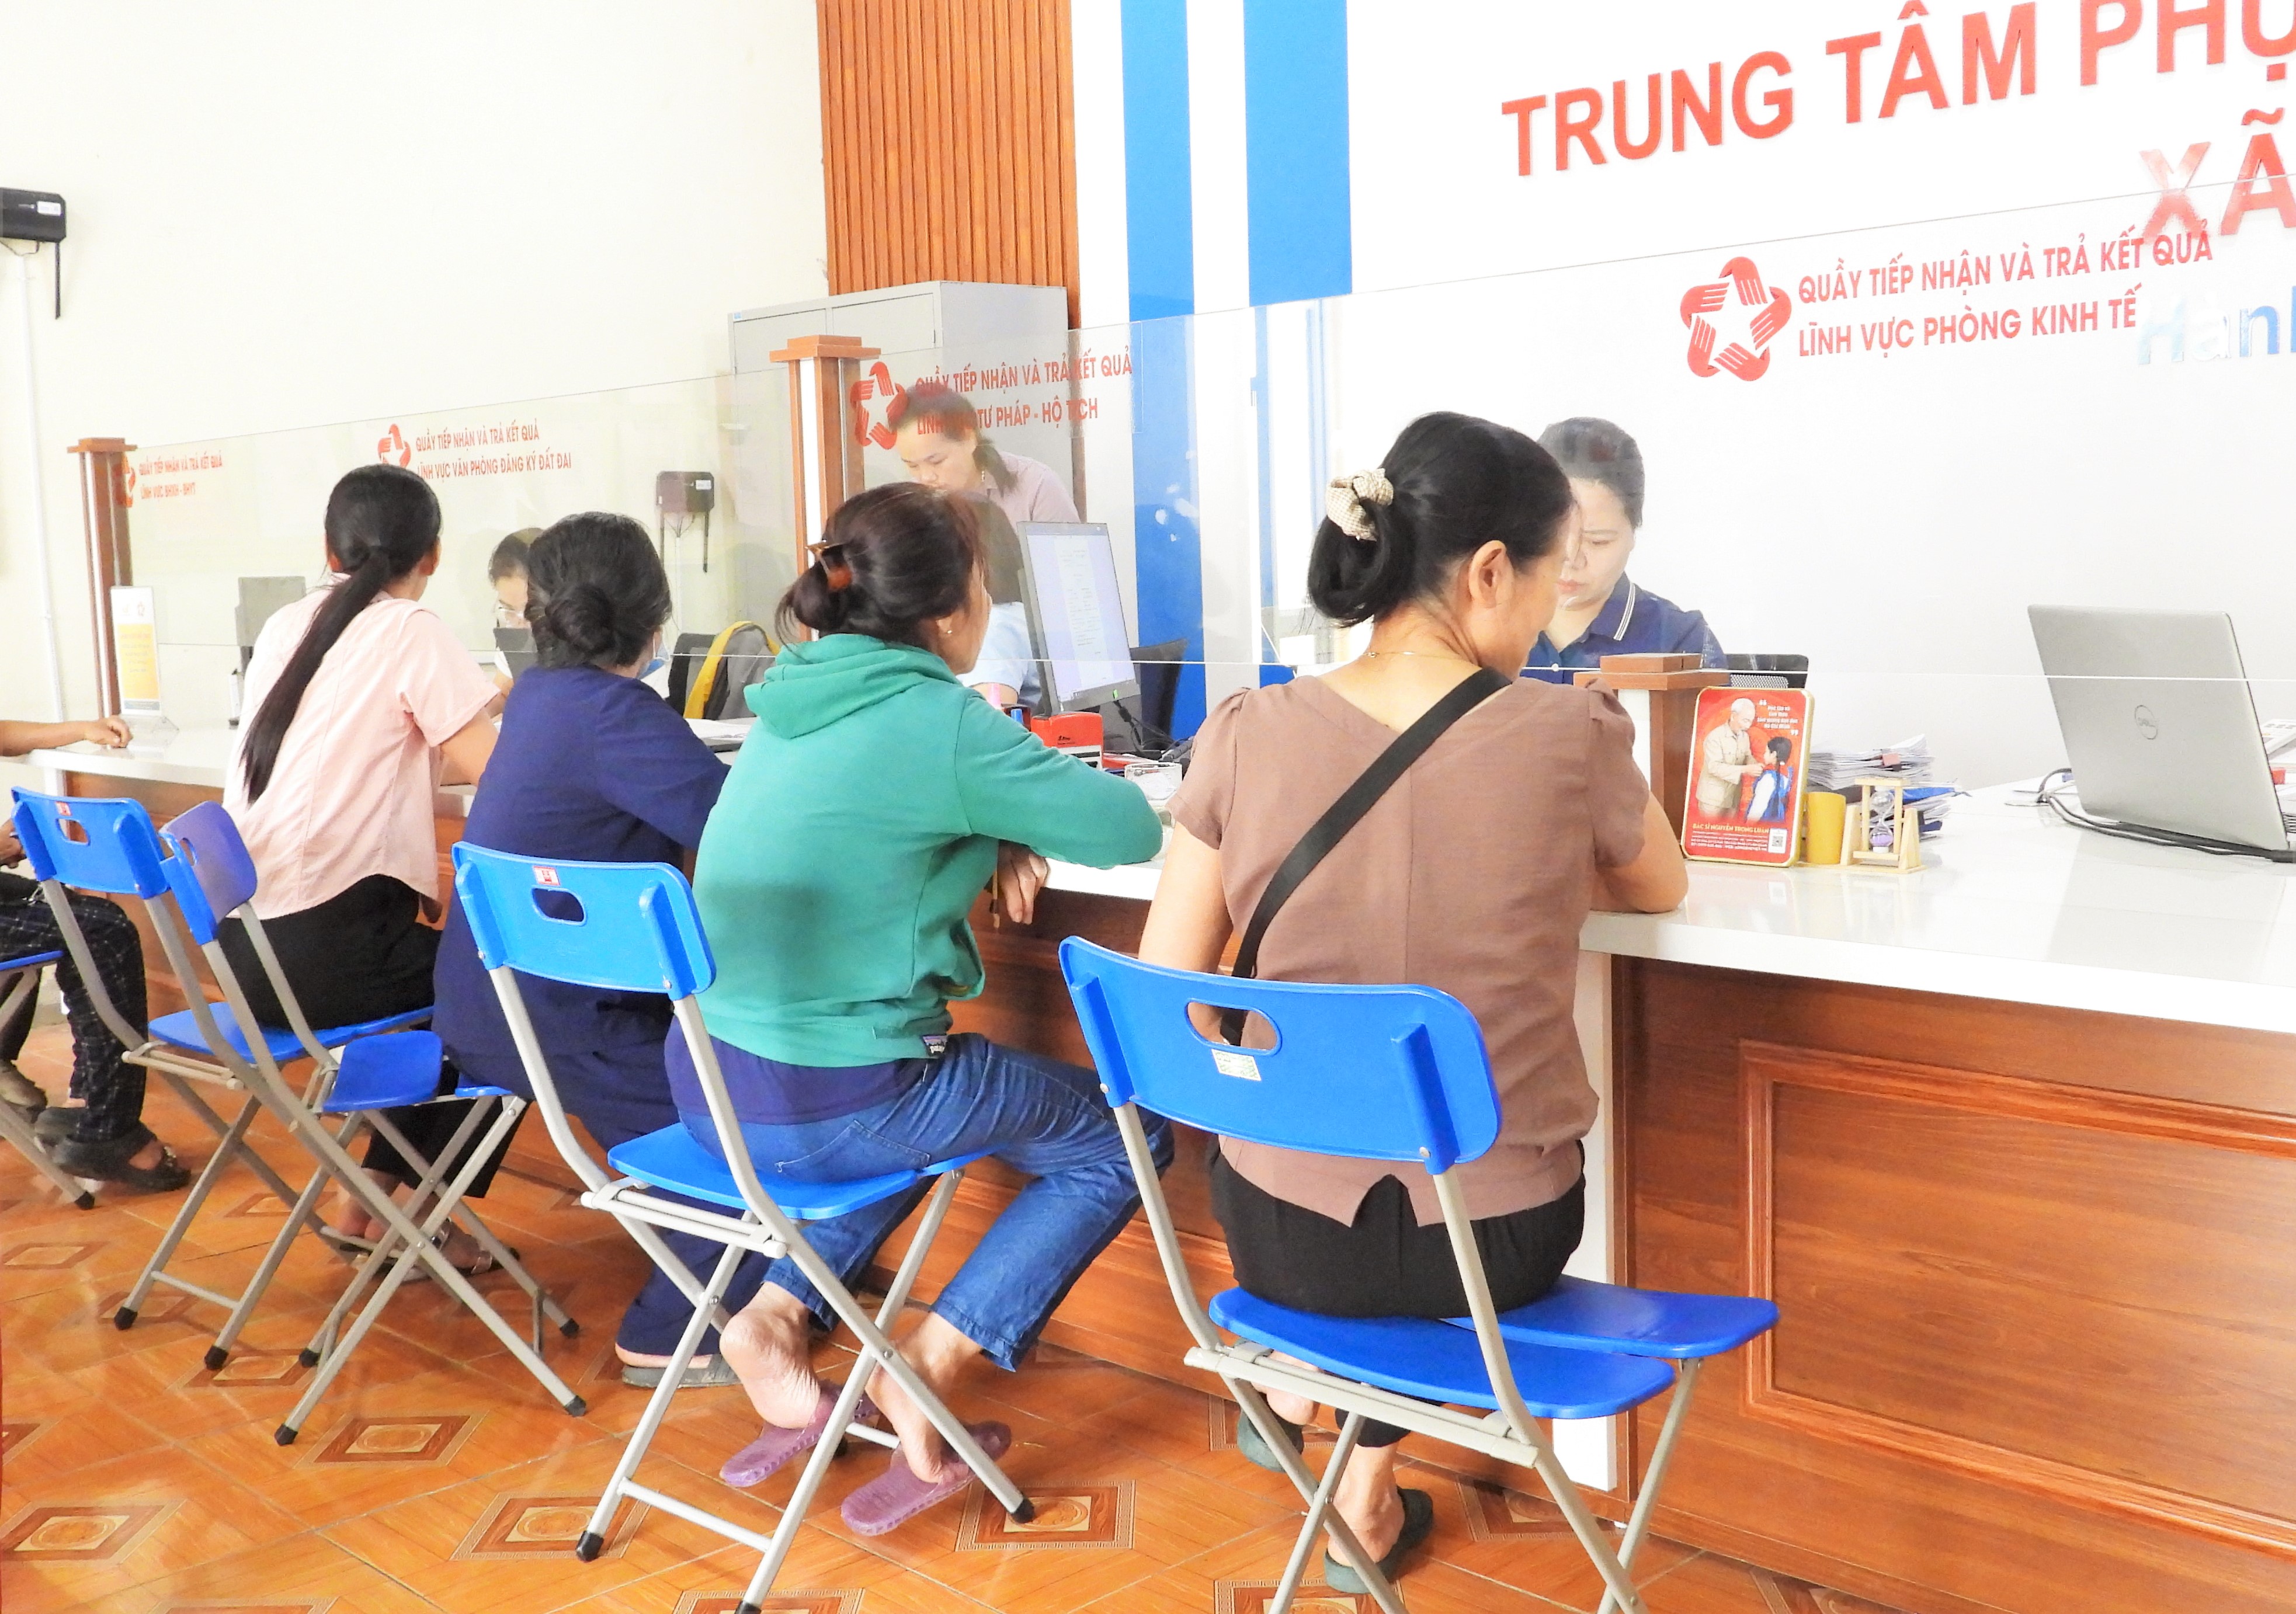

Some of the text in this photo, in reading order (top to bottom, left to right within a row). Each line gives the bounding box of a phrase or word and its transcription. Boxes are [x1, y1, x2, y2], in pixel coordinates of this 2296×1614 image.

[1501, 50, 1793, 177] TRUNG
[1826, 0, 2036, 124] TÂM
[2139, 107, 2296, 237] XÃ
[1799, 218, 2213, 304] QUẦY TIẾP NHẬN VÀ TRẢ KẾT QUẢ
[1799, 283, 2142, 358] LĨNH VỰC PHÒNG KINH TẾ
[953, 363, 977, 392] TIẾP
[981, 361, 1018, 394] NHẬN
[1022, 357, 1041, 384] VÀ
[1044, 353, 1069, 383] TRẢ
[1071, 347, 1096, 380] KẾT
[1100, 346, 1133, 377] QUẢ
[437, 427, 451, 449] TIẾP
[453, 427, 475, 451] NHẬN
[477, 425, 488, 446] VÀ
[489, 421, 504, 444] TRẢ
[506, 419, 519, 443] KẾT
[522, 418, 540, 441] QUẢ
[977, 405, 992, 429] TƯ
[996, 399, 1031, 427] PHÁP
[1042, 395, 1062, 429] HỘ
[452, 458, 468, 477] VĂN
[470, 455, 498, 476] PHÒNG
[526, 450, 536, 471] KÝ
